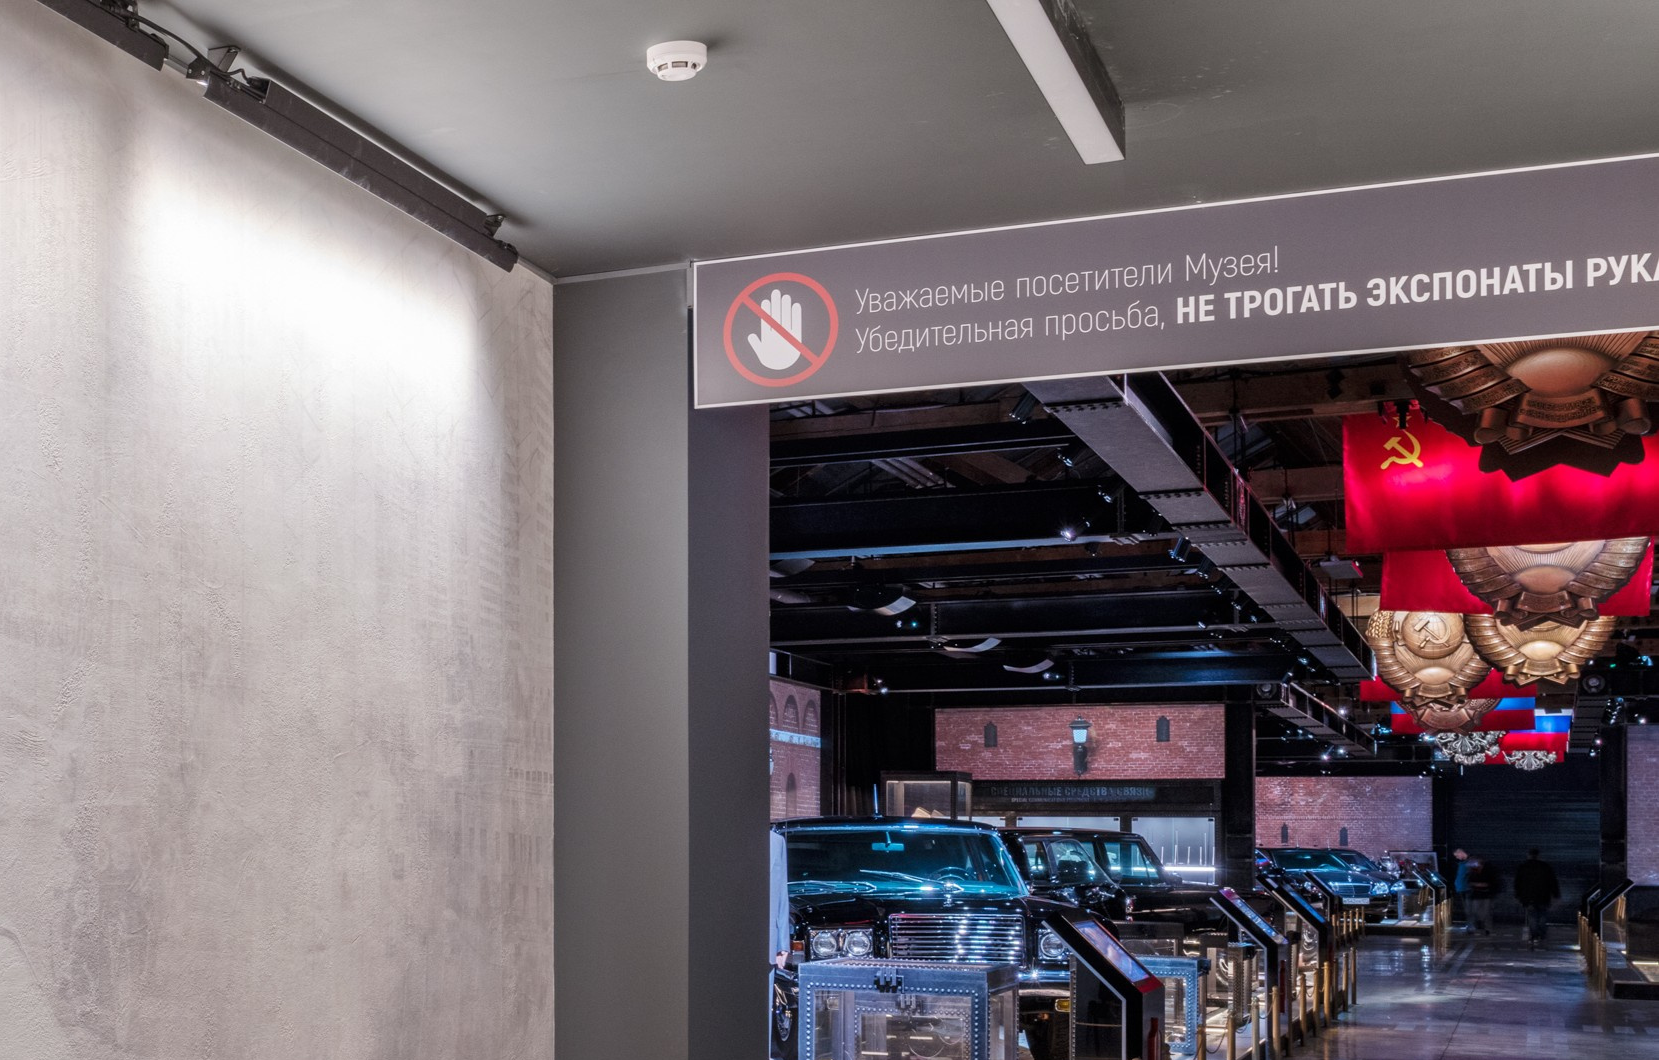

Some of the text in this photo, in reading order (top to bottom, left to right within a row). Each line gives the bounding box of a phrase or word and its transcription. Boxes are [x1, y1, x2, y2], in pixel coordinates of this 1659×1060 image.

[854, 245, 1279, 315] Уважаемые посетители Музея!
[854, 317, 1034, 354] Убедительная
[1045, 299, 1166, 341] просьба,
[1176, 293, 1216, 325] НЕ
[1223, 281, 1358, 320] ТРОГАТЬ
[1366, 259, 1574, 307] ЭКСПОНАТЫ
